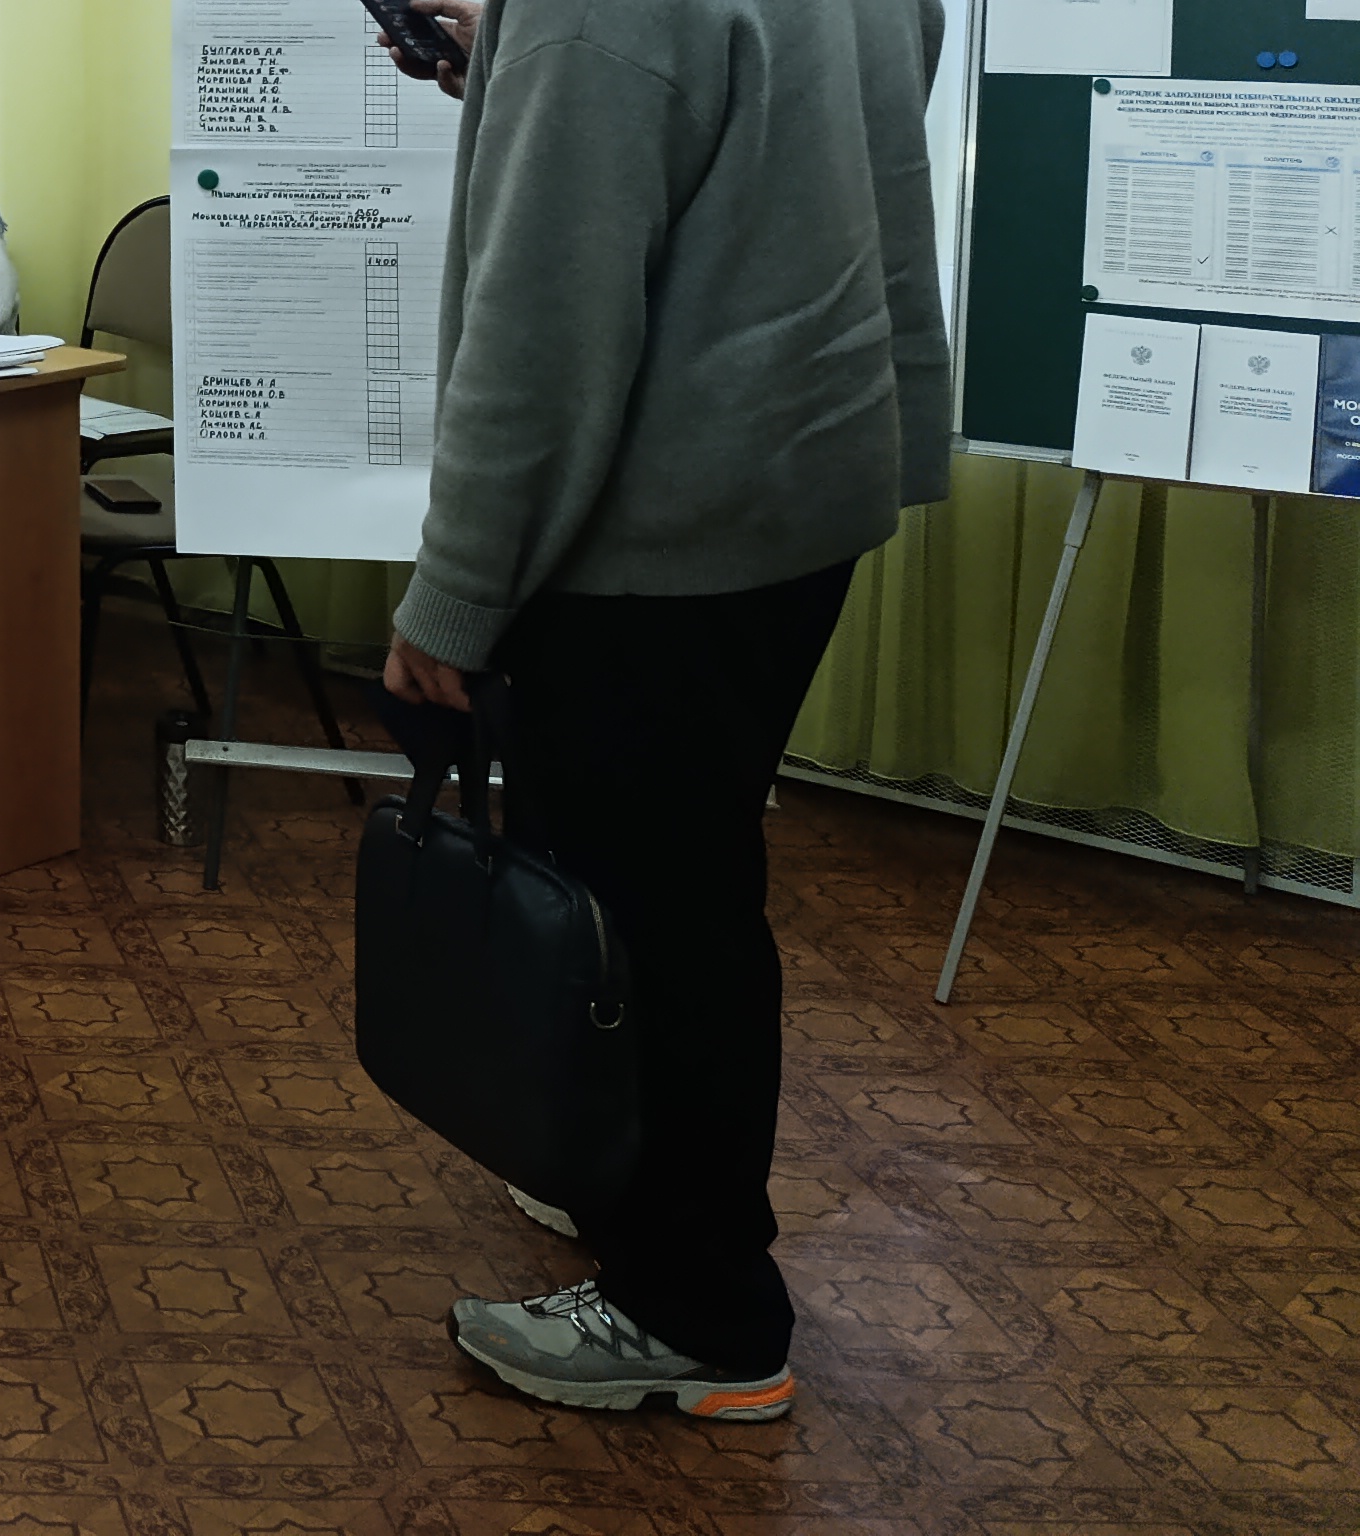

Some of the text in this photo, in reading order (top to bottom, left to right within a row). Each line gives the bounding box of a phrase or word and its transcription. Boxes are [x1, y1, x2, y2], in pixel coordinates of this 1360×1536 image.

[202, 44, 261, 56] БУЛГАКОВ
[202, 375, 252, 388] БРЫНЦЕВ
[1333, 399, 1360, 411] МО
